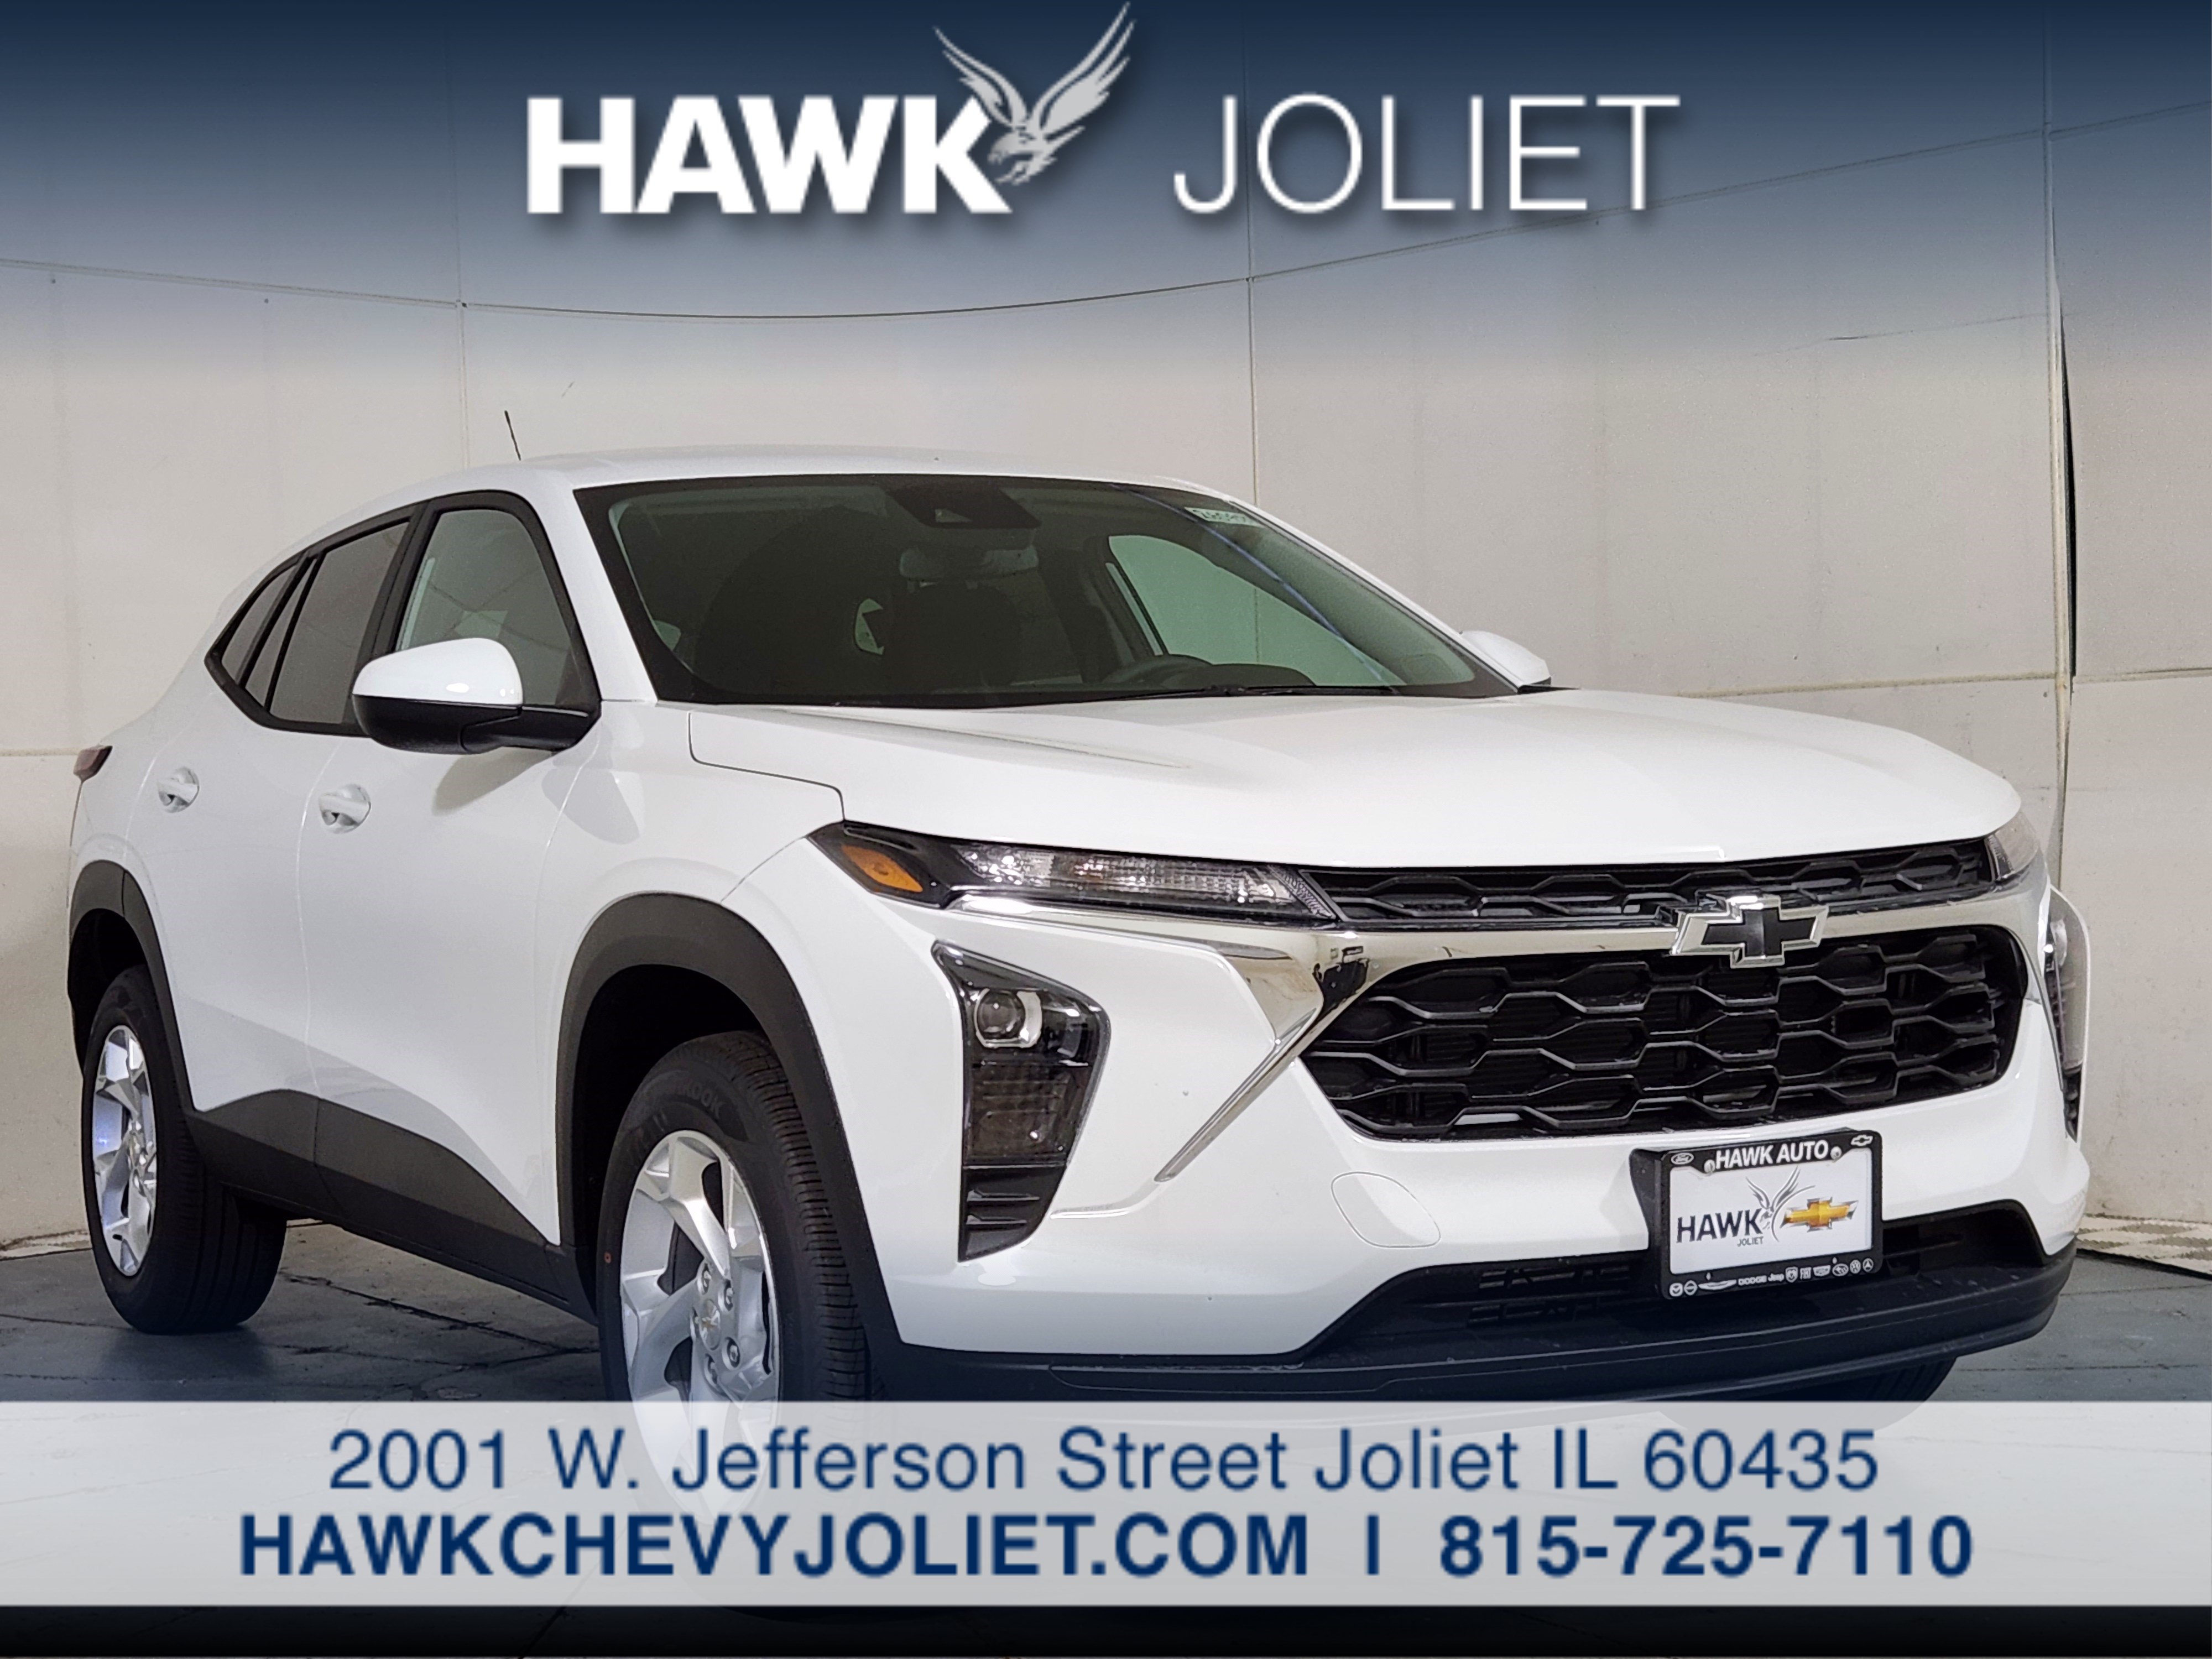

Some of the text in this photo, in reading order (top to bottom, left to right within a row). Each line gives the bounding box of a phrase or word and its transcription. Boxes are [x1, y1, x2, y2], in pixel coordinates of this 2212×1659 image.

[1715, 1139, 1829, 1170] HAWK AUTO
[1676, 1208, 1763, 1244] HAWK
[1737, 1236, 1764, 1248] JOLIET
